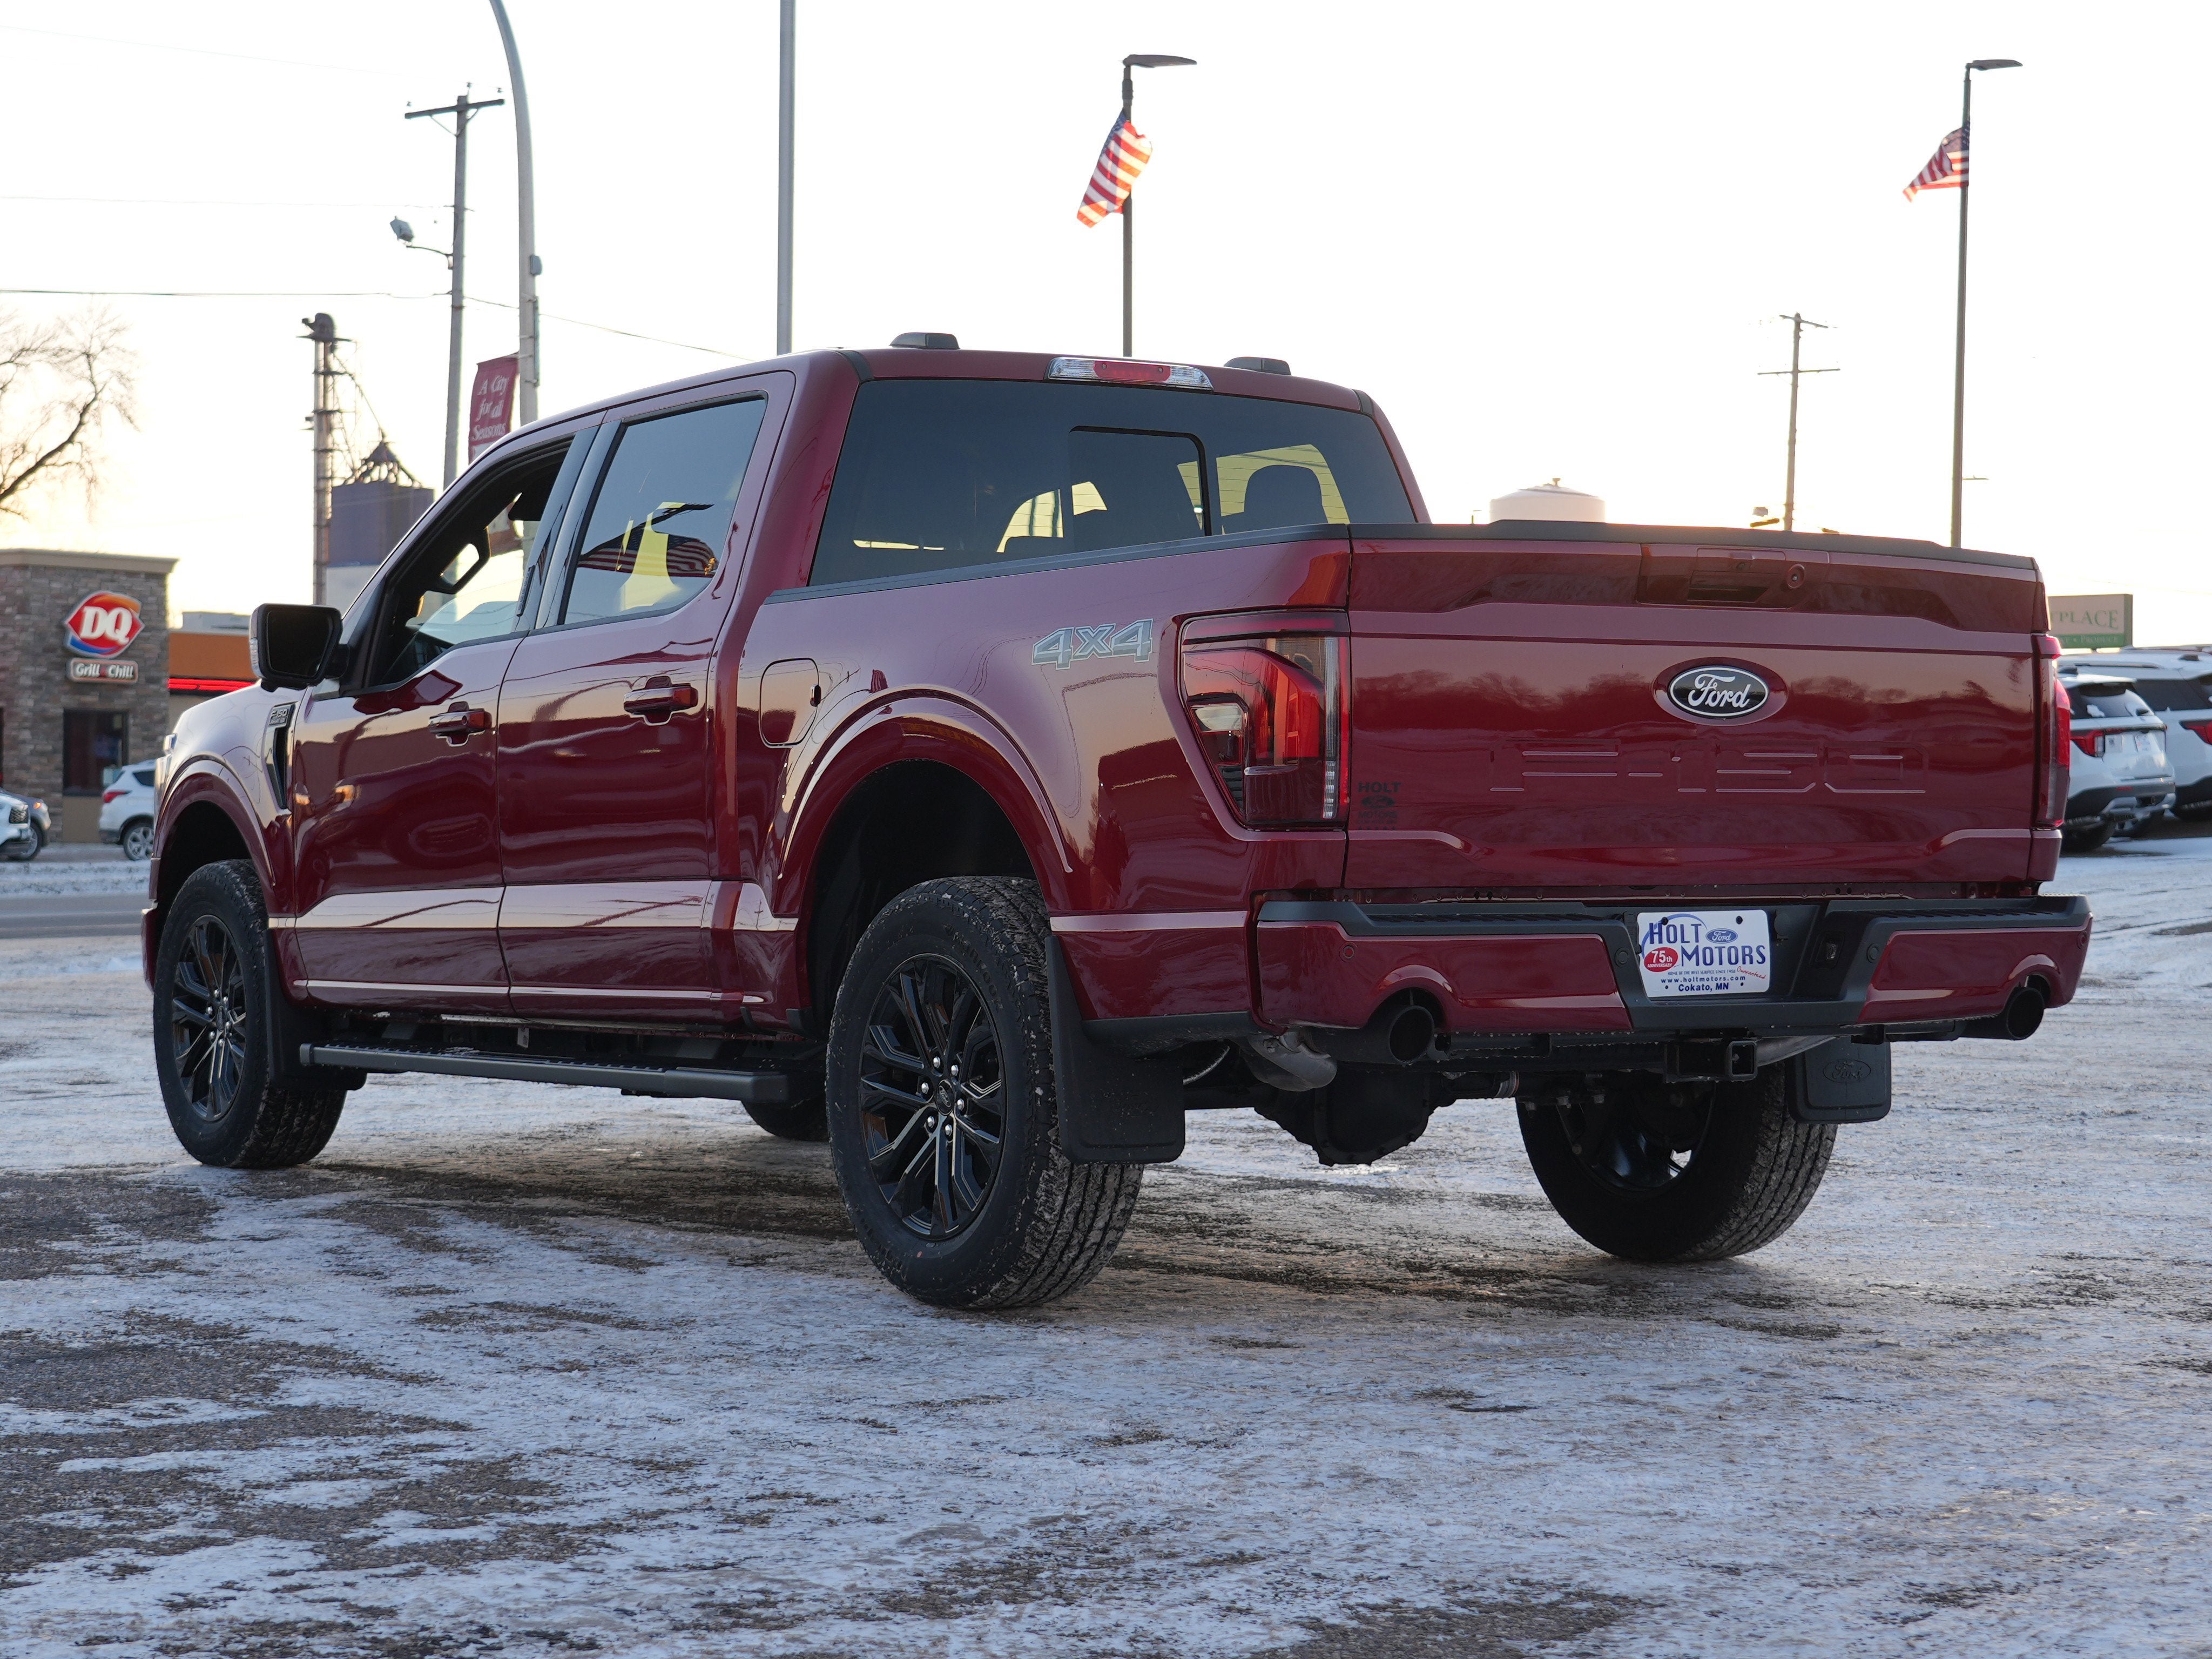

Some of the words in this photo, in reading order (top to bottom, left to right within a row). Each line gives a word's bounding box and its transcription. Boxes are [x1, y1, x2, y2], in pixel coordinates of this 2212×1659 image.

[477, 379, 488, 395] A
[490, 375, 509, 396] City
[475, 399, 494, 422] for
[490, 400, 504, 419] all
[471, 423, 507, 441] Seasons
[80, 606, 132, 645] DQ
[76, 663, 100, 678] Grill
[107, 665, 133, 679] Chill
[1688, 673, 1751, 708] Ford
[1358, 781, 1401, 793] HOLT
[1649, 922, 1702, 945] HOLT
[1712, 930, 1731, 941] Ford
[1651, 950, 1673, 963] 75th
[1681, 945, 1766, 967] MOTORS
[1661, 975, 1745, 983] www.holtmotors.com
[1736, 966, 1766, 980] Guaranteed
[1678, 983, 1712, 992] Cokato,
[1715, 982, 1729, 990] MN
